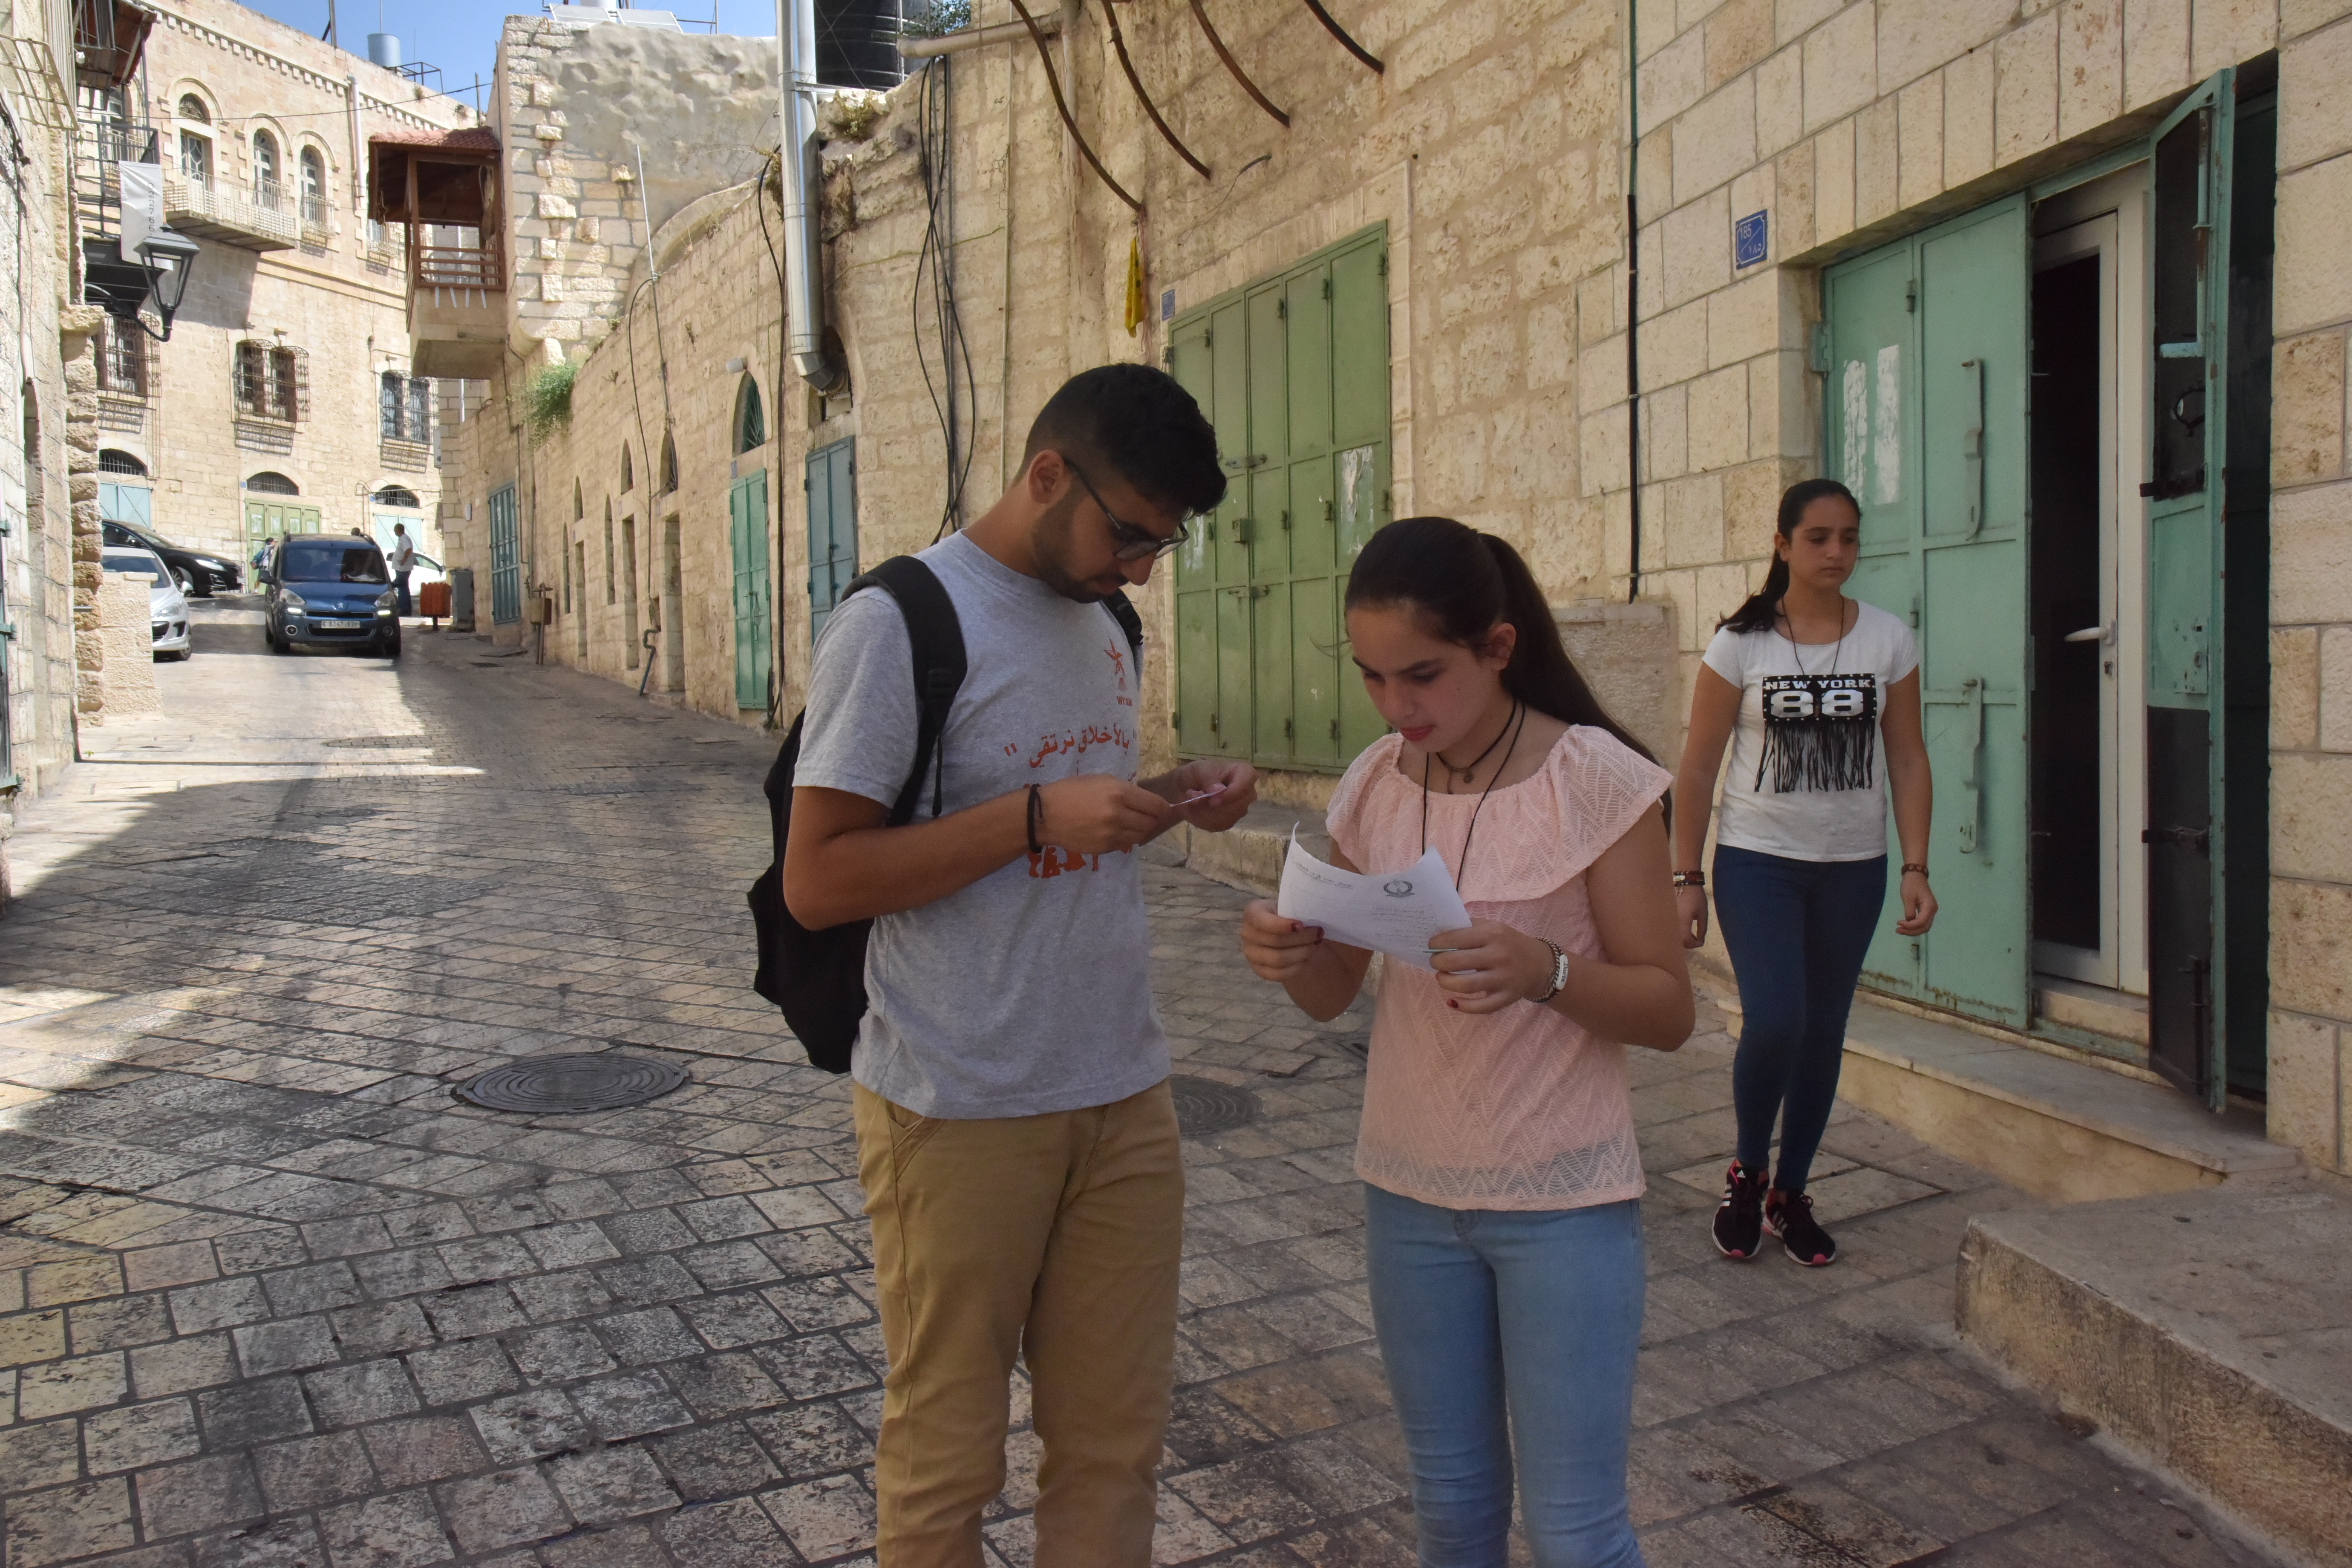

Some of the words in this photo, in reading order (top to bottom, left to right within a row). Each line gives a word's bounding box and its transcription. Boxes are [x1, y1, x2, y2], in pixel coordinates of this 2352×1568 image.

[1740, 224, 1752, 240] 185
[1765, 681, 1810, 690] NEW
[1817, 679, 1871, 688] YORK
[1771, 689, 1864, 718] 88
